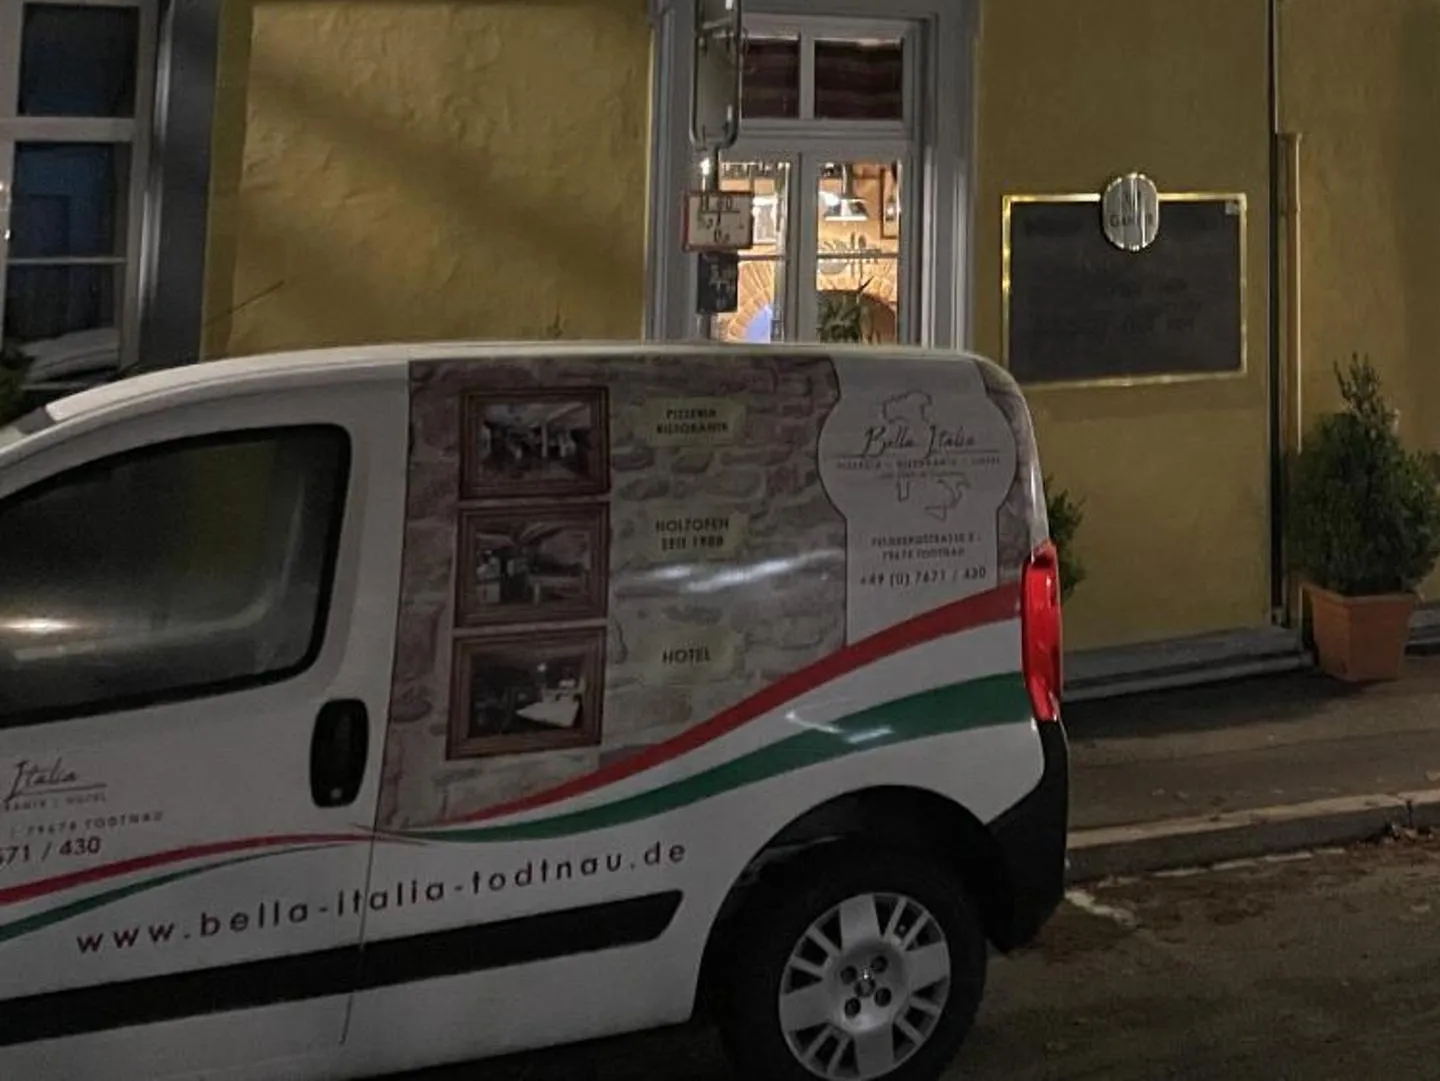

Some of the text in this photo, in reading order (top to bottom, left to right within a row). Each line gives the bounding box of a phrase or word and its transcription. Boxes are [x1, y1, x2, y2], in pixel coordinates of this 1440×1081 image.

[662, 647, 711, 664] HOTEL
[3, 756, 78, 802] Italia
[58, 836, 101, 856] 430
[76, 841, 686, 954] www.bella-italia-todtnau.de
